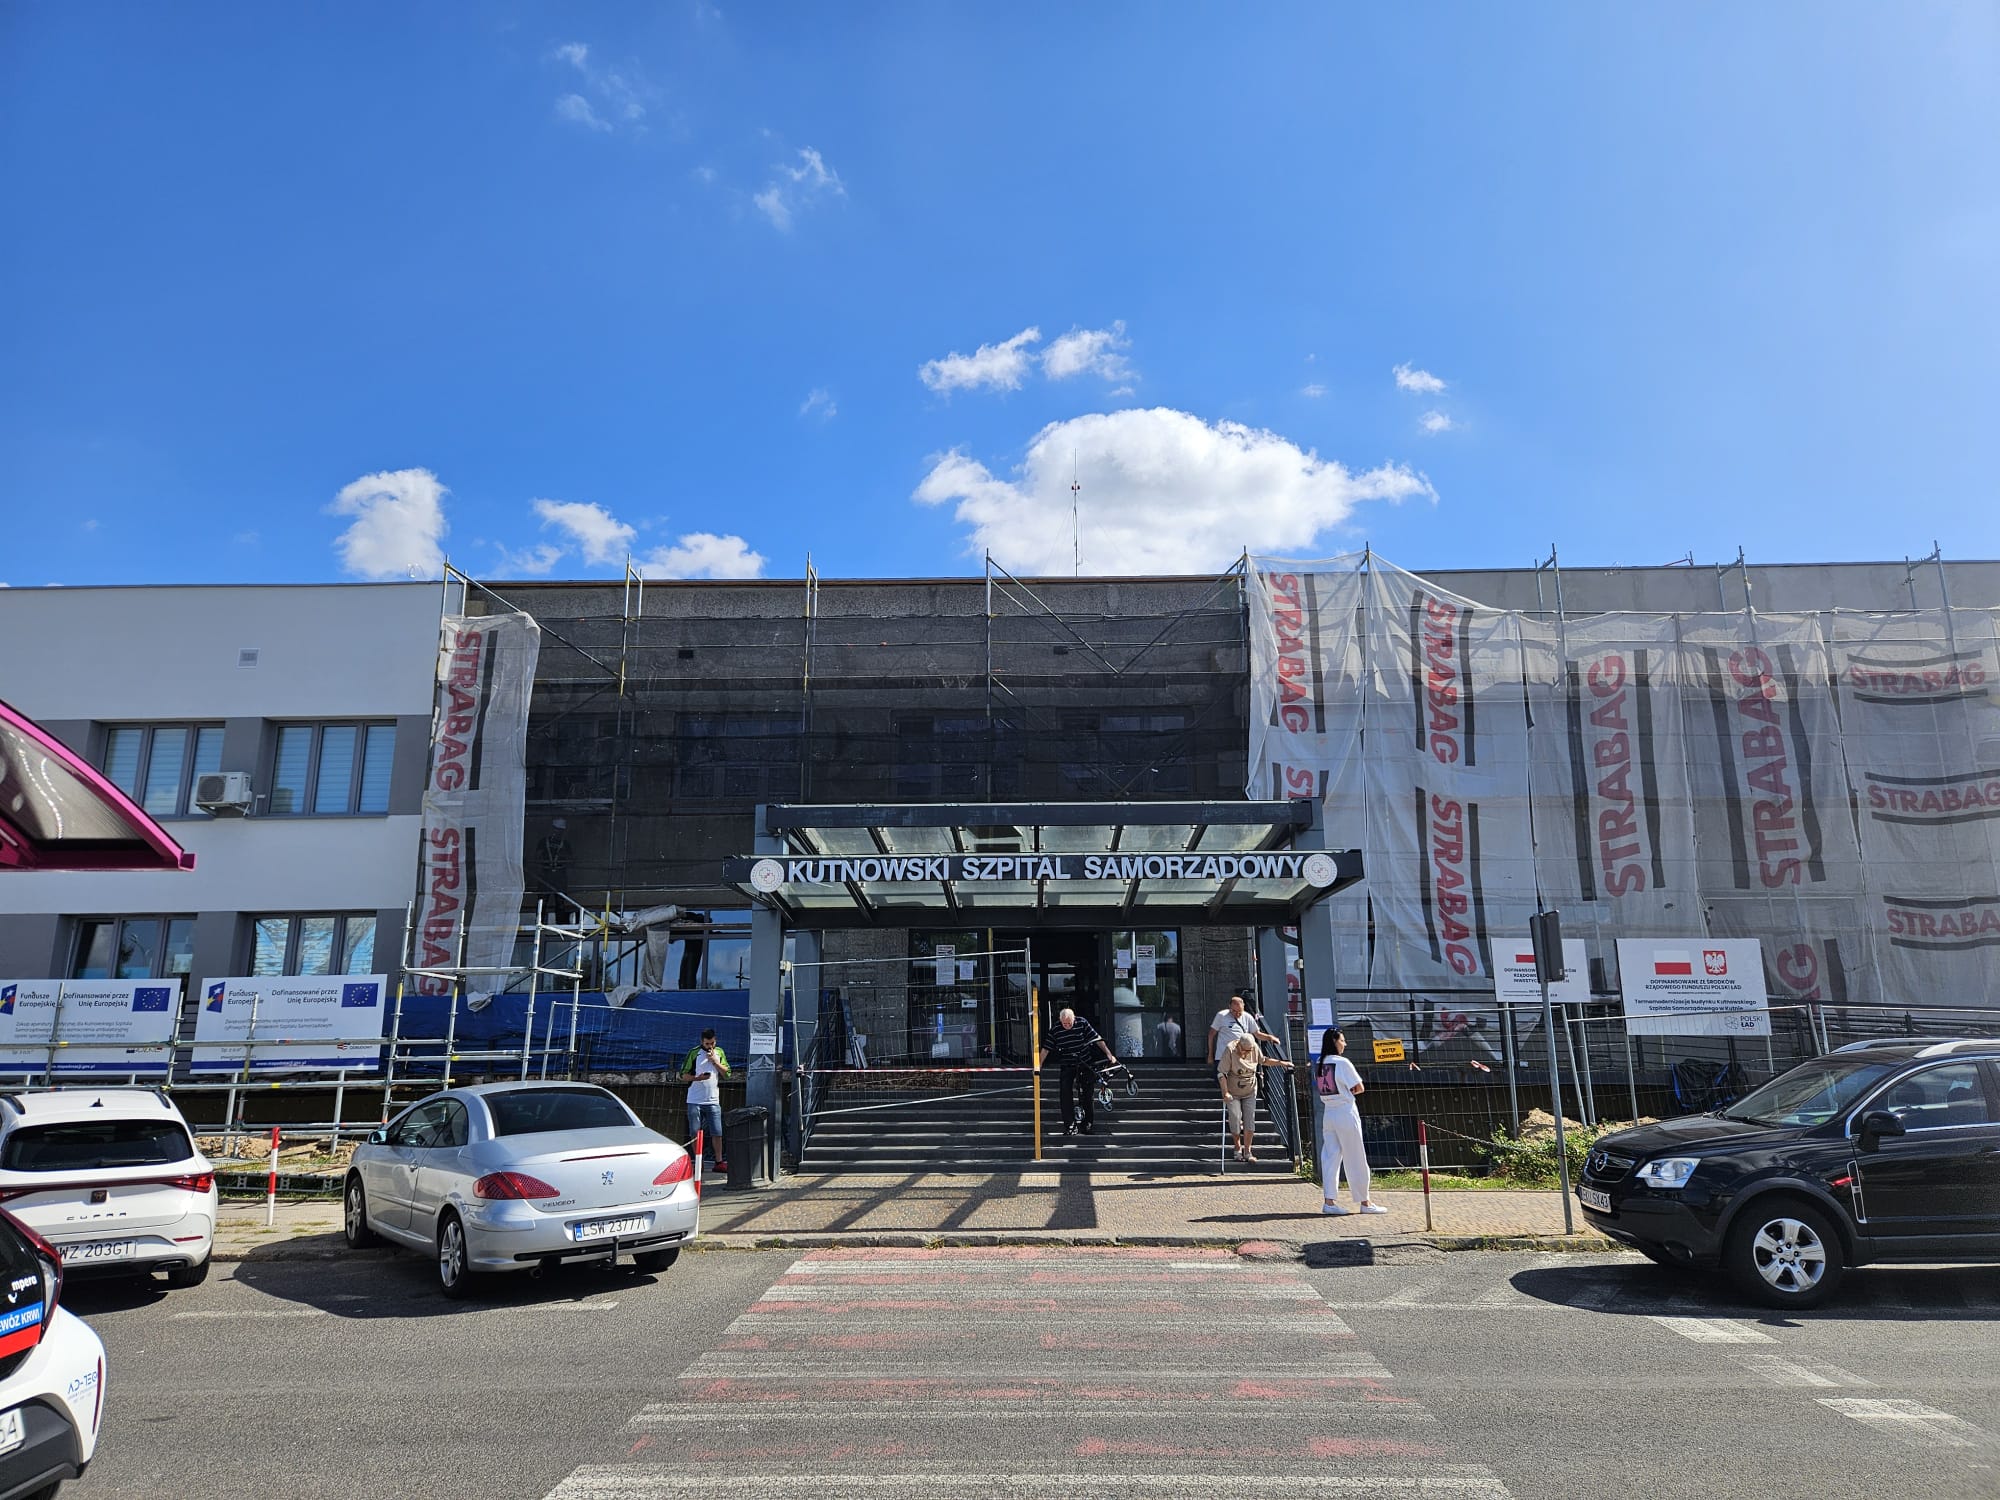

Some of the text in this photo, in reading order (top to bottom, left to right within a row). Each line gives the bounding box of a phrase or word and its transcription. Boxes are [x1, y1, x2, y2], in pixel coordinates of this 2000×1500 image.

[1270, 572, 1310, 734] STRABAG
[1424, 596, 1460, 764] STRABAG
[1850, 662, 1986, 694] STRABAG
[435, 631, 482, 791] STRABAG
[1587, 655, 1646, 897] STRABAG
[1728, 647, 1801, 889] STRABAG
[788, 858, 949, 882] KUTNOWSKI
[962, 856, 1071, 880] SZPITAL
[1084, 855, 1304, 884] SAMORZĄDOWY
[1432, 794, 1477, 976] STRABAG
[111, 993, 129, 1001] przez
[228, 989, 258, 997] Fundusze
[78, 1000, 93, 1008] Unię
[543, 1199, 576, 1208] PEUGEOT
[66, 1212, 127, 1221] CUPRA
[582, 1216, 642, 1237] LSW 23777
[84, 1241, 132, 1258] 203GT
[11, 1274, 38, 1292] mpera
[21, 1308, 40, 1325] KRWI
